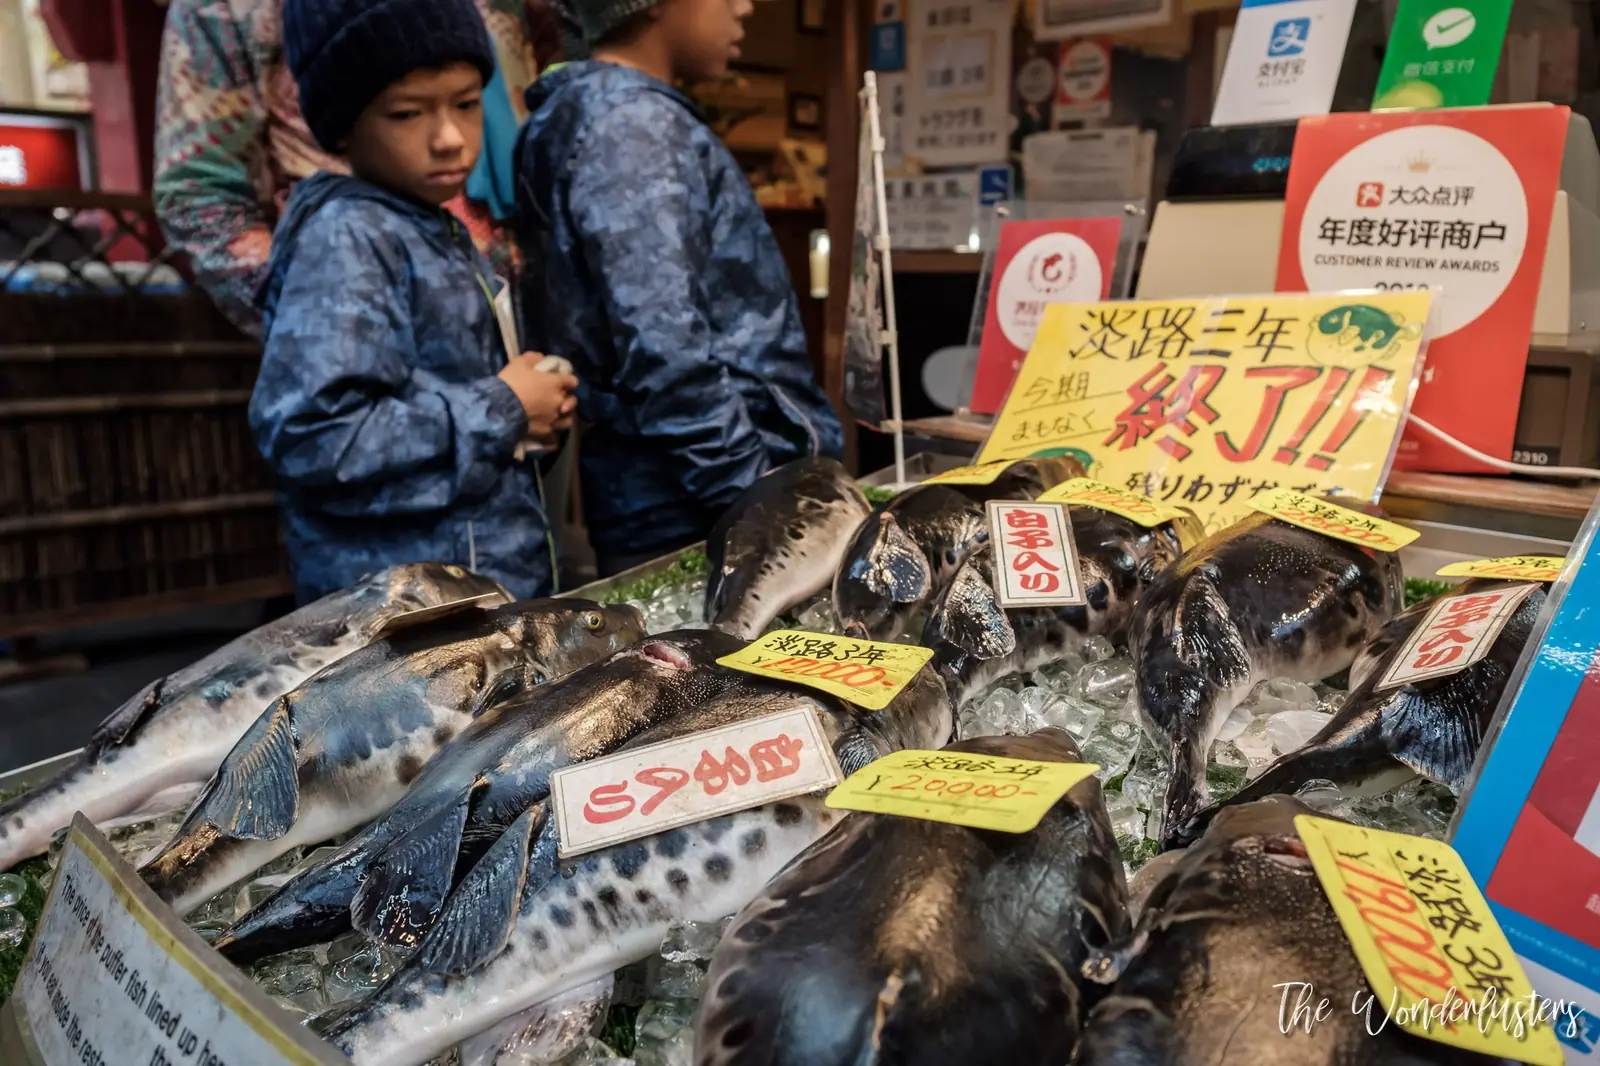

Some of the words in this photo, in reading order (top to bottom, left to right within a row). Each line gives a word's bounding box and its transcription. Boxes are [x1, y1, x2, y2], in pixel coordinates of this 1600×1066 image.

[1388, 185, 1475, 207] 大众点评
[1317, 216, 1507, 250] 年度好评商户
[1315, 254, 1383, 268] CUSTOMER
[1386, 256, 1437, 270] REVIEW
[1440, 258, 1500, 273] AWARDS
[1068, 305, 1300, 363] 淡路三年
[1022, 371, 1091, 406] 今期
[1012, 409, 1096, 442] まもなく
[764, 634, 888, 665] 淡路3年
[62, 874, 76, 905] The
[72, 895, 91, 928] price
[99, 943, 128, 985] puffer
[124, 969, 148, 1009] fish
[145, 990, 182, 1039] lined
[177, 1026, 198, 1057] up
[66, 1012, 82, 1048] the
